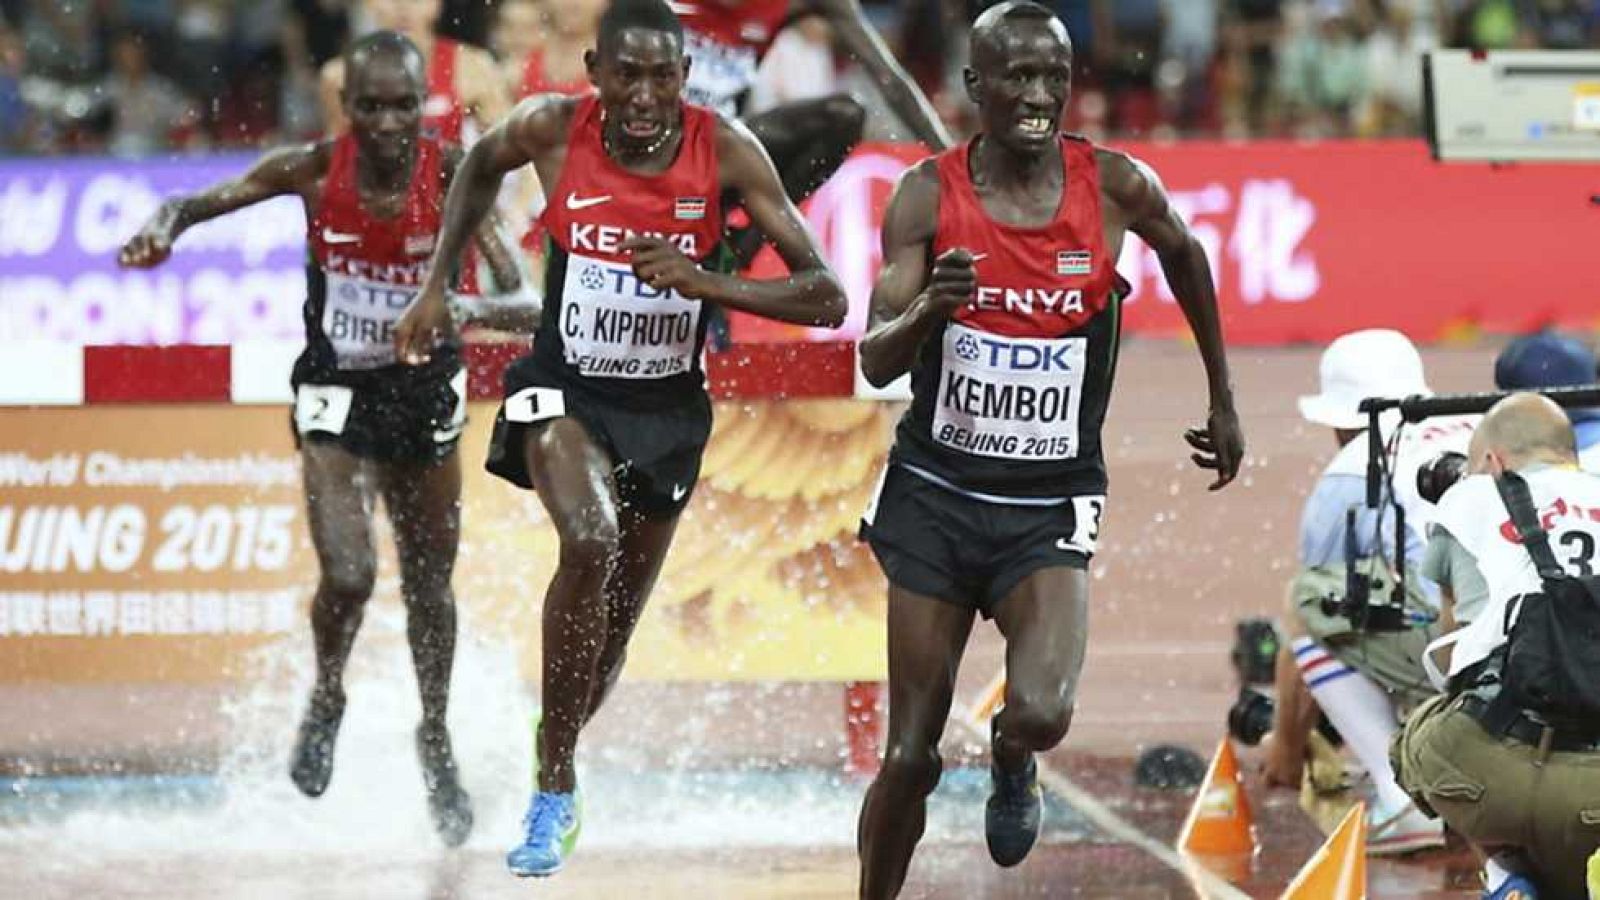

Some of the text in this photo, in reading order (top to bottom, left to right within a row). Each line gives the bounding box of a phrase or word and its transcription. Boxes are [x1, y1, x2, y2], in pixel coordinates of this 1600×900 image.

[570, 221, 698, 257] KEA
[362, 284, 420, 308] TD
[967, 286, 1084, 314] ENYA
[330, 308, 398, 344] BIRE
[565, 302, 692, 347] C. KIPRUTO
[571, 351, 685, 375] EIJING 2015
[981, 338, 1073, 371] TDK
[310, 398, 331, 421] 2
[525, 391, 540, 414] 1
[944, 370, 1072, 424] KEMBOI
[938, 423, 1071, 456] BEIJING 2015
[1087, 500, 1102, 541] 3
[151, 504, 297, 573] 2015
[1559, 530, 1596, 577] 3
